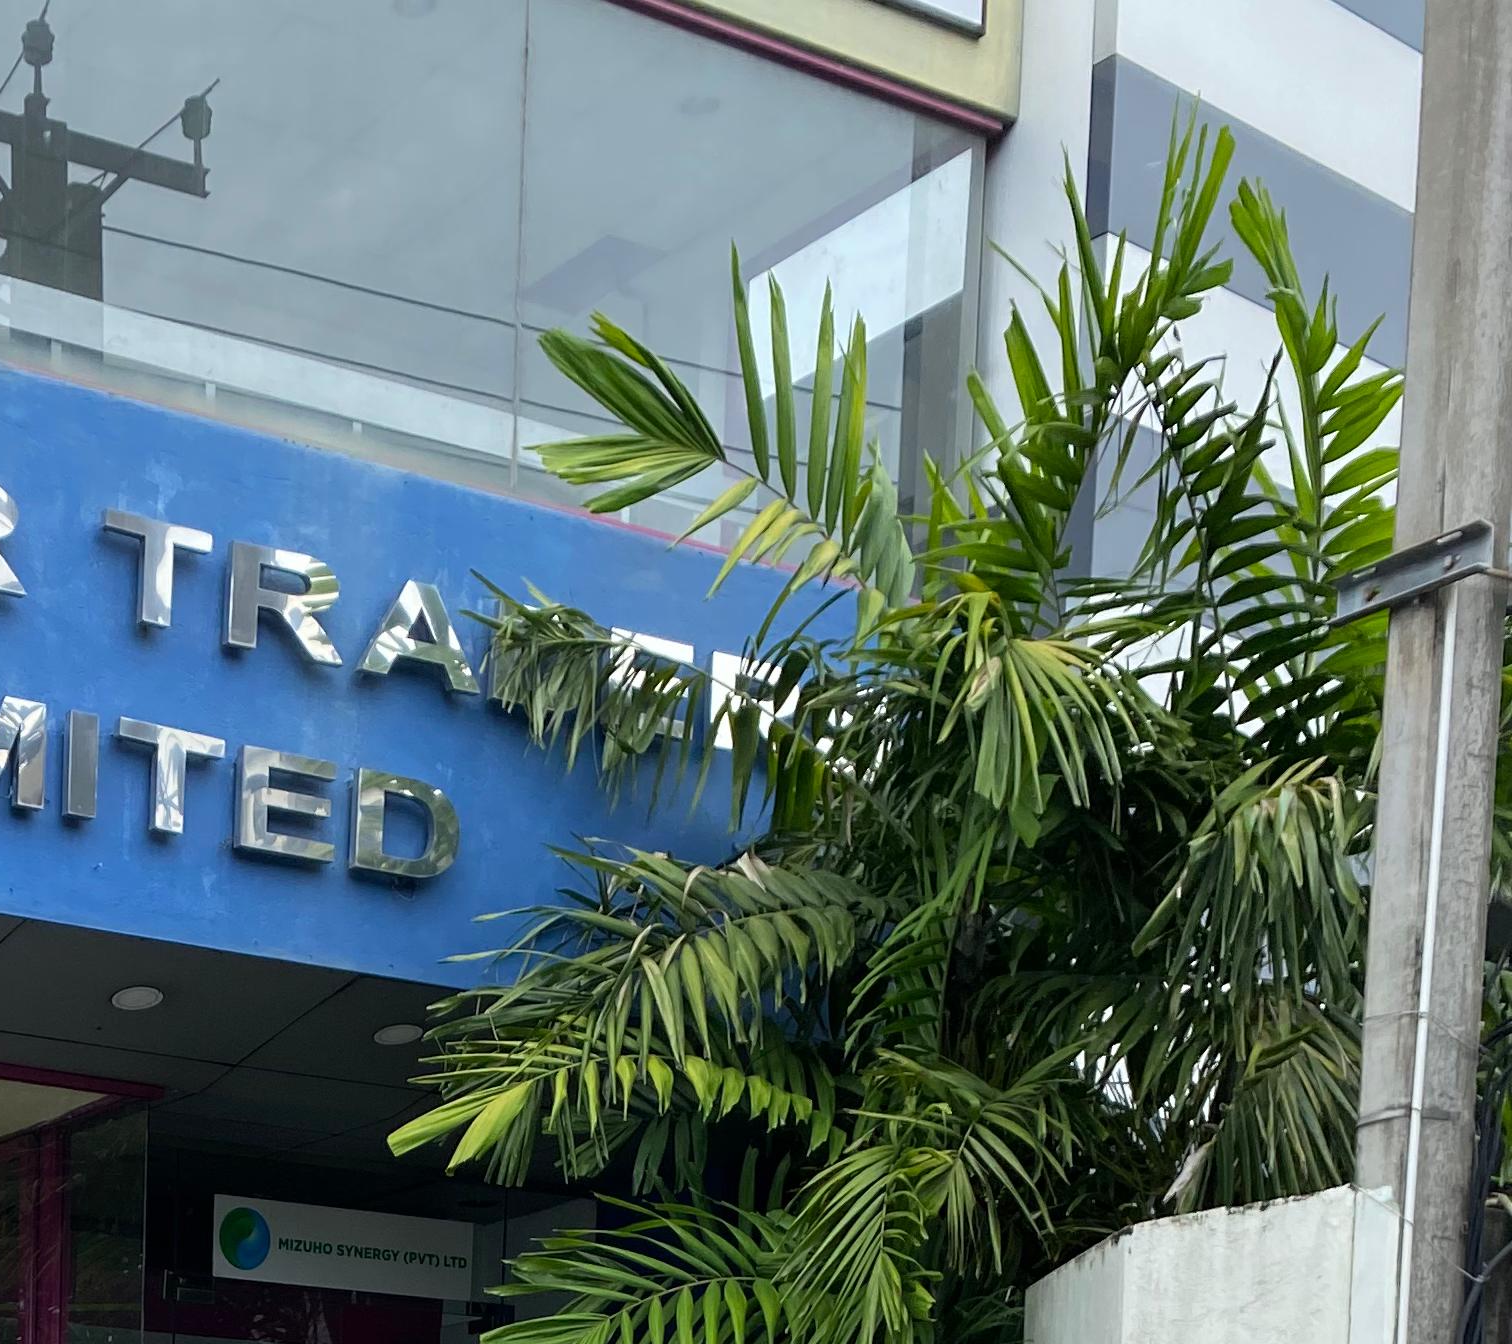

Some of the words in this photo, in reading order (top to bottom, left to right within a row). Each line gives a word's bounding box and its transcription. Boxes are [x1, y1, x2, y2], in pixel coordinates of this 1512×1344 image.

[278, 1237, 333, 1255] MIZUHO
[336, 1243, 400, 1262] SYNERGY
[403, 1250, 440, 1268] (PVT)
[443, 1256, 468, 1269] LTD
